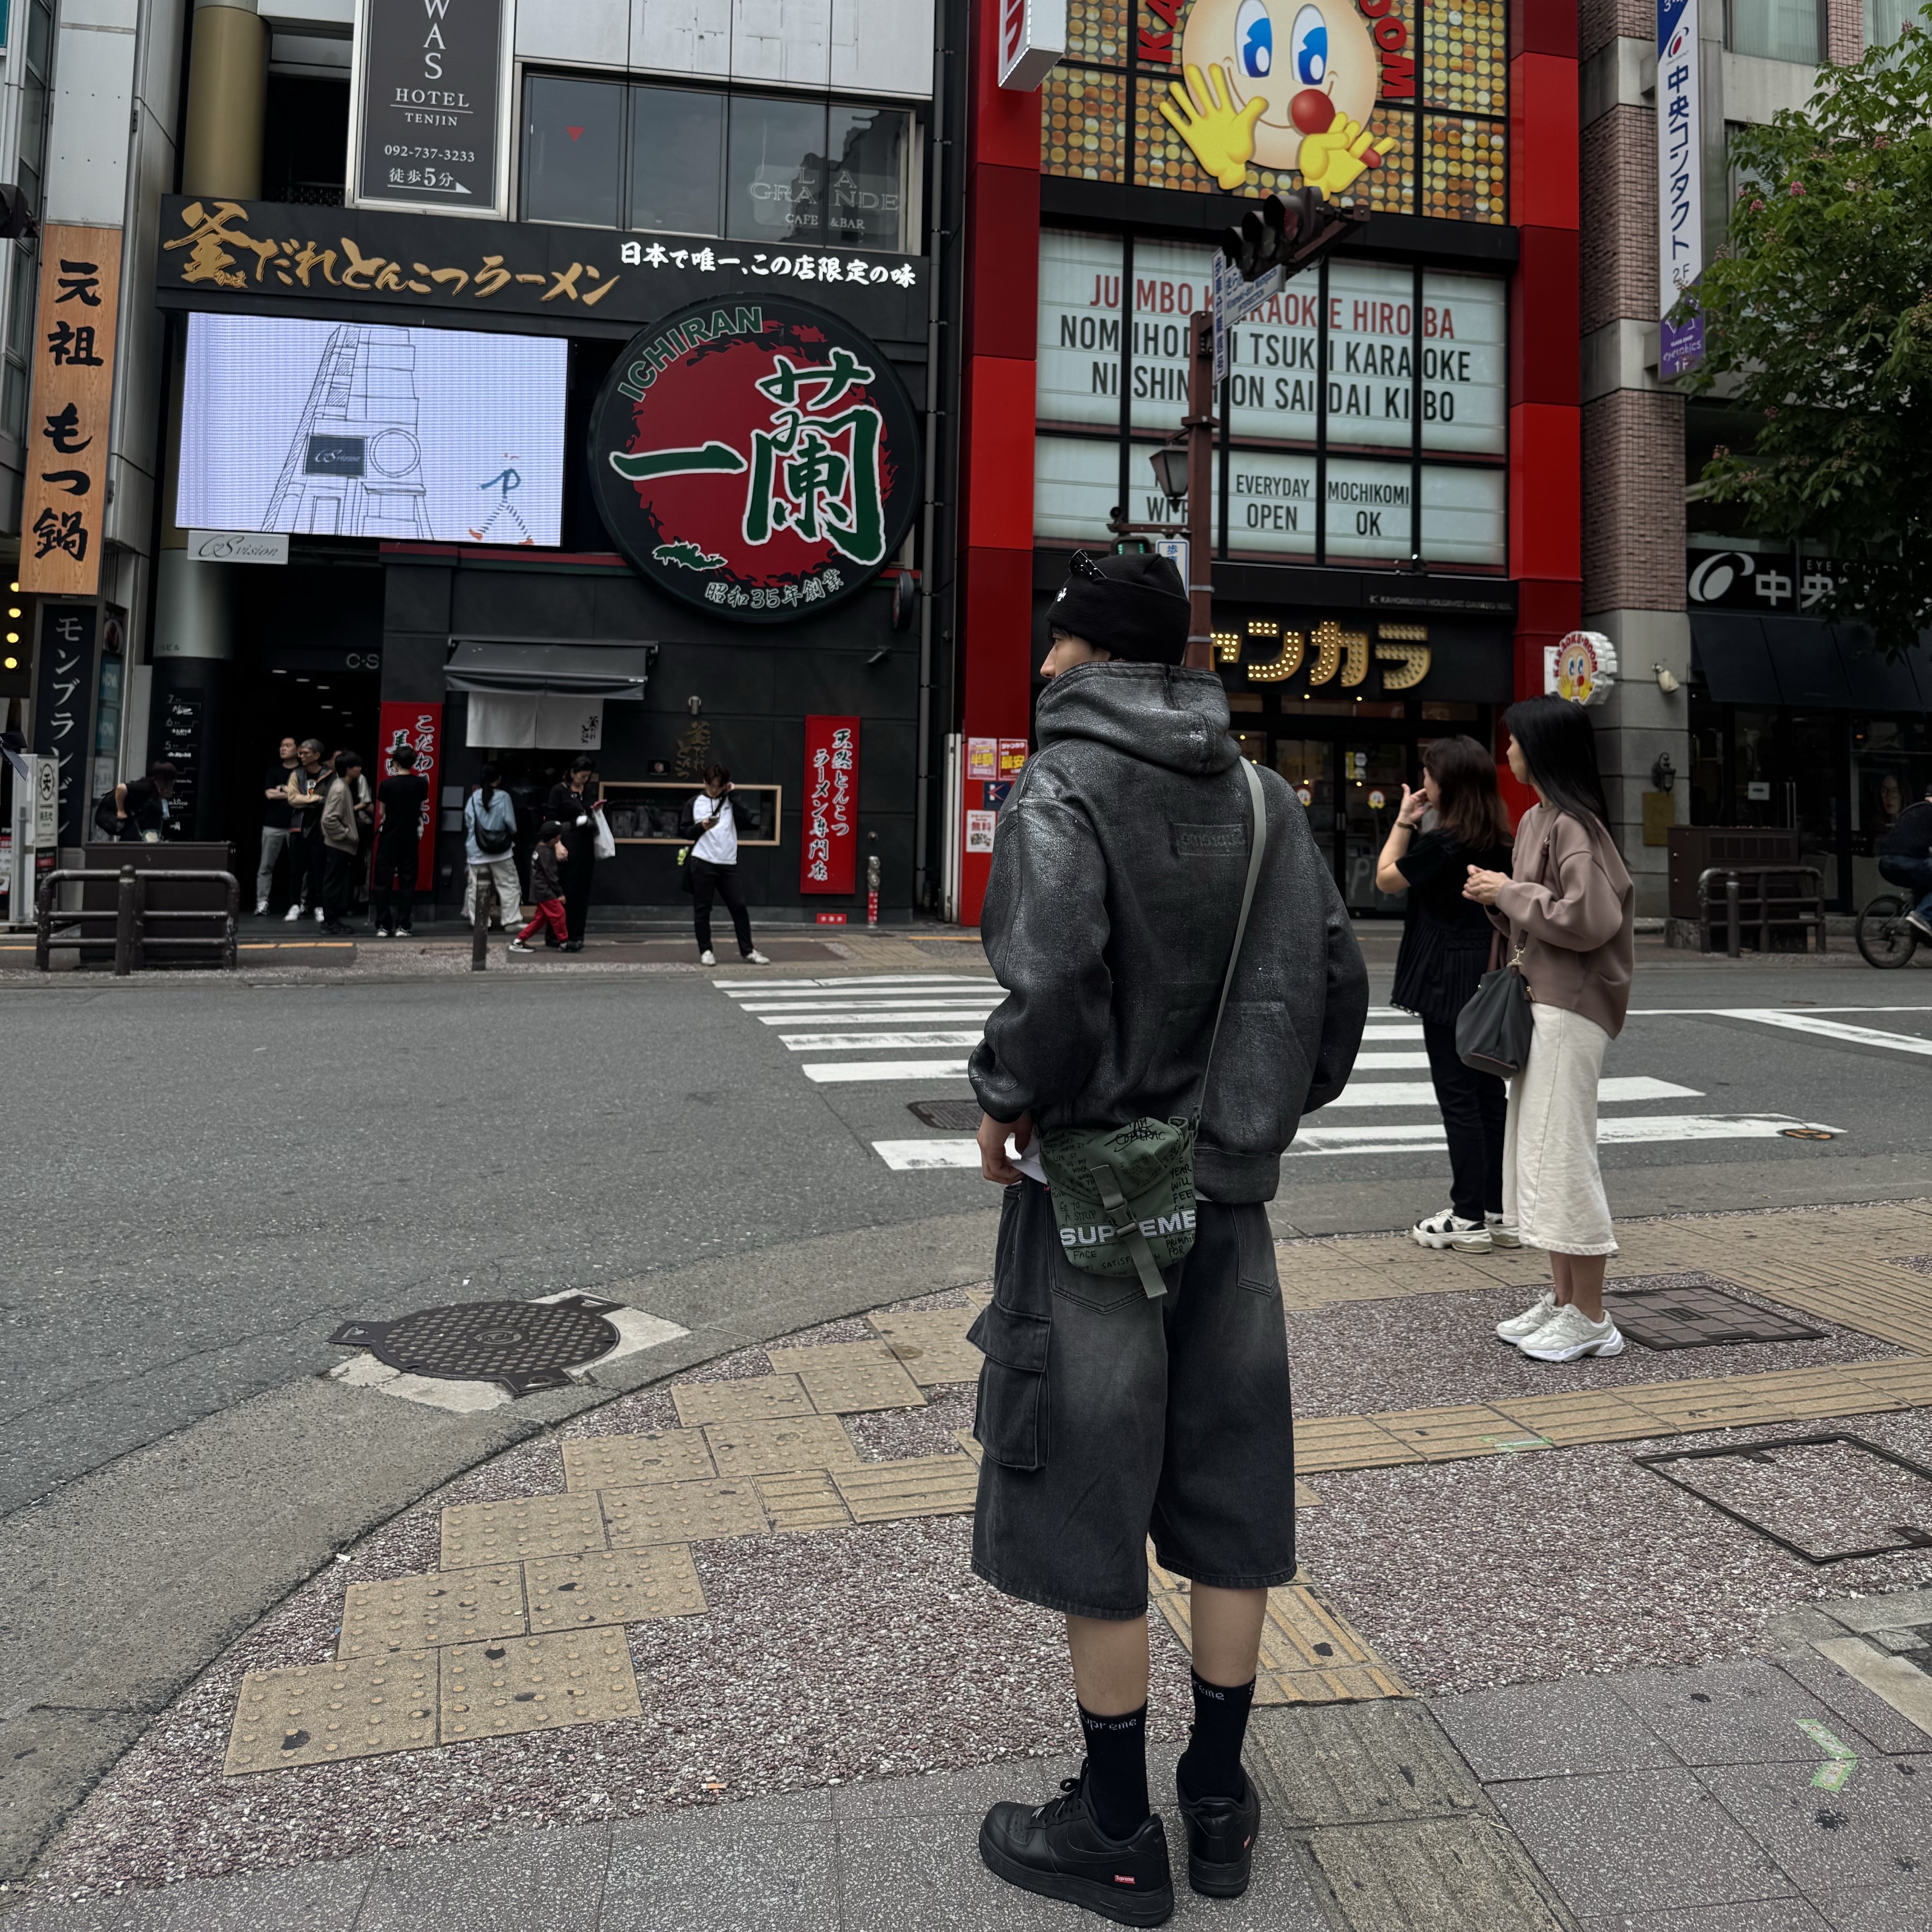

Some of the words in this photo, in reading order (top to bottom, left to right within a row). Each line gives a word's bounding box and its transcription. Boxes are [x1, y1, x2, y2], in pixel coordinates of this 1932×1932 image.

[395, 88, 470, 108] HOTEL
[405, 113, 458, 126] TENJIN
[384, 145, 475, 163] 092-737-3233
[1668, 66, 1689, 260] 中央コンタクト
[388, 167, 454, 187] 徒歩5分
[749, 182, 899, 211] GRANDE
[785, 213, 819, 225] CAFE
[163, 201, 621, 307] 釜だれとんこつラーメン
[621, 241, 916, 288] 日本で唯一、この店限定の味
[1090, 274, 1192, 315] JUMBO
[1353, 300, 1455, 339] HIROBA
[617, 307, 762, 402] ICHIRAN
[1250, 333, 1333, 370] TSUKI
[1346, 341, 1471, 382] KARAOKE
[1385, 387, 1454, 422] KIBO
[609, 347, 886, 566] 一蘭
[1236, 474, 1310, 497] EVERYDAY
[1328, 481, 1410, 506] MOCHIKOMI
[1247, 503, 1297, 531] OPEN
[1356, 511, 1381, 536] OK
[1807, 559, 1832, 572] EYE
[704, 569, 845, 609] 昭和35年創業
[831, 728, 853, 837] 天然とんこつ
[807, 749, 830, 882] ラーメン専門店
[1061, 1210, 1196, 1246] SUPEME
[1073, 1250, 1097, 1260] FACE
[1168, 1246, 1185, 1258] FOR
